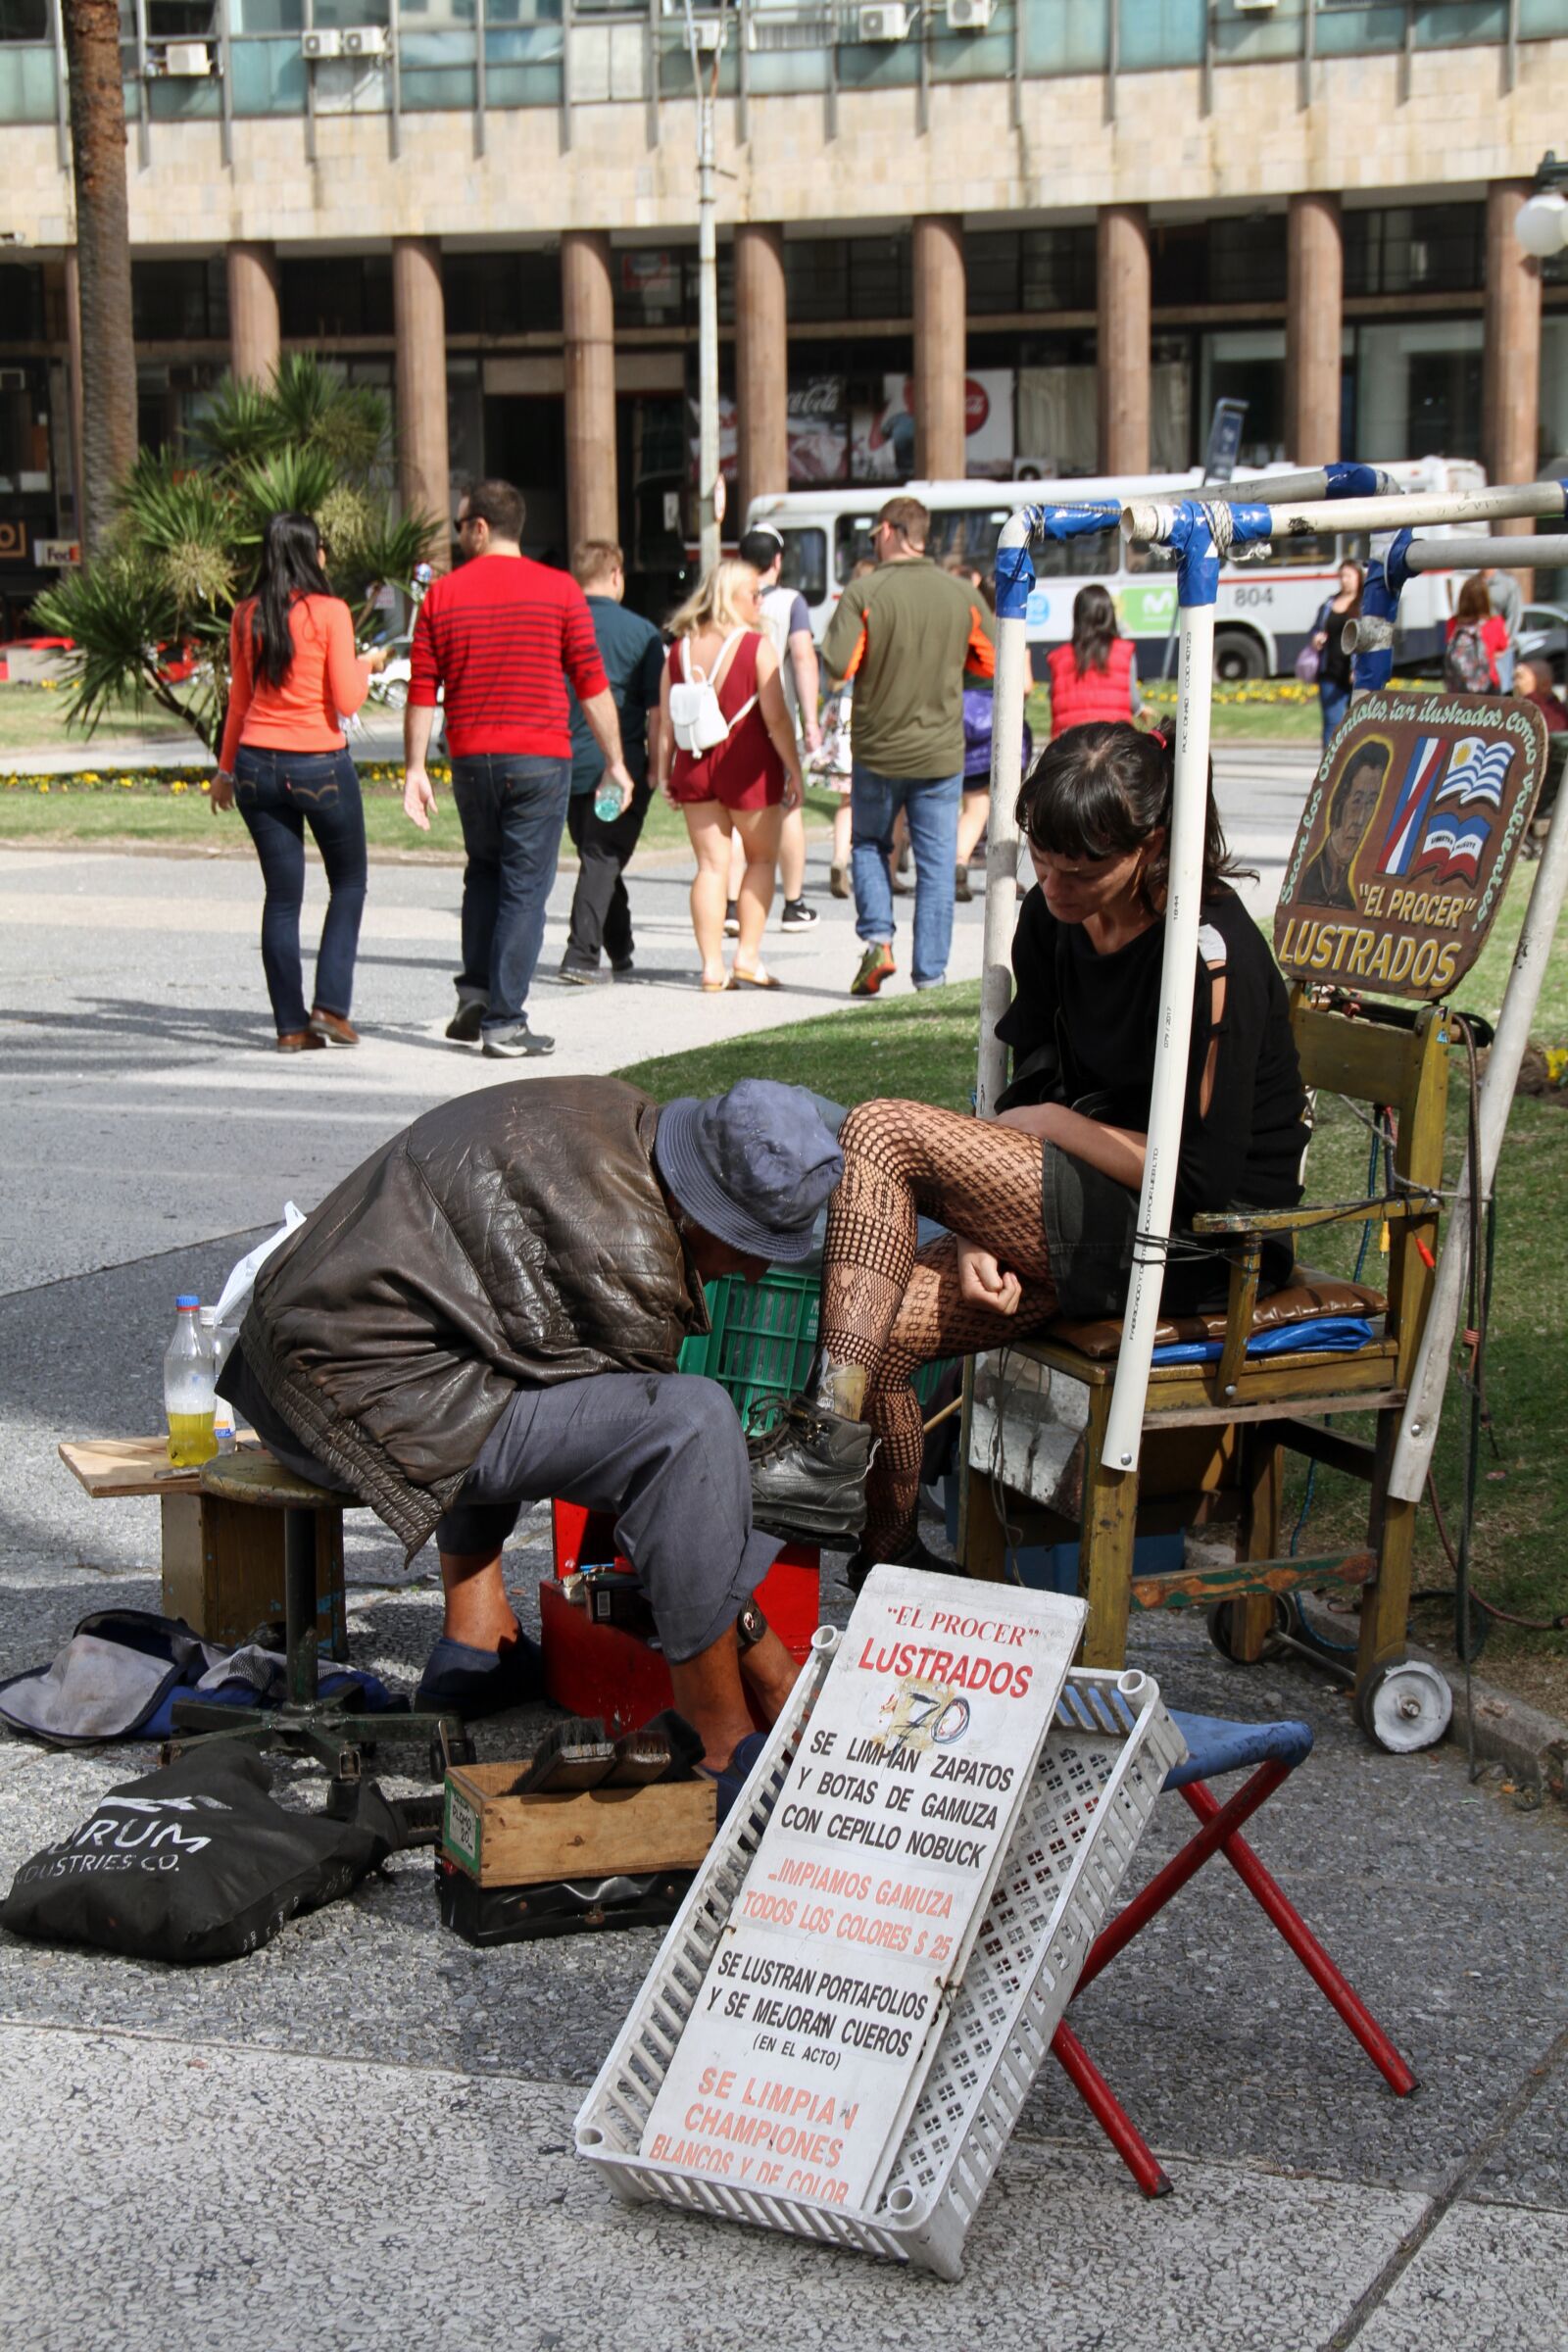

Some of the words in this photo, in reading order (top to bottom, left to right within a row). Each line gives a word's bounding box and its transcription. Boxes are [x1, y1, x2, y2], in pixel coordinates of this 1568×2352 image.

[1235, 587, 1273, 608] 804
[1389, 697, 1418, 722] tan
[1417, 695, 1505, 730] ilustrados,
[1505, 710, 1538, 765] como
[1359, 883, 1387, 918] "EL
[1386, 888, 1478, 930] PROCER"
[1278, 917, 1463, 988] LUSTRADOS
[1129, 1284, 1142, 1341] FABRICADO
[887, 1605, 927, 1629] "EL
[930, 1611, 1040, 1648] PROCER"
[858, 1637, 1034, 1699] LUSTRADOS
[809, 1730, 838, 1757] SE
[846, 1738, 922, 1774] LIMPIAN
[930, 1754, 1015, 1792] ZAPATOS
[797, 1766, 813, 1790] Y
[816, 1771, 879, 1805] BOTAS
[885, 1786, 915, 1813] DE
[921, 1792, 999, 1831] GAMUZA
[140, 1853, 180, 1872] CO.
[780, 1803, 824, 1835] CON
[826, 1813, 903, 1851] CEPILLO
[905, 1830, 988, 1869] NOBUCK
[742, 1889, 799, 1927] TODOS
[798, 1903, 835, 1935] LOS
[836, 1912, 912, 1952] COLORES
[913, 1930, 929, 1956] $
[928, 1934, 954, 1961] 25
[875, 1880, 955, 1920] GAMUZA
[717, 1949, 744, 1978] SE
[741, 1954, 818, 1995] LUSTRAN
[814, 1972, 929, 2021] PORTAFOLIOS
[706, 1985, 723, 2012] Y
[723, 1989, 751, 2019] SE
[752, 1996, 838, 2039] MEJORAN
[840, 2018, 913, 2058] CUEROS
[752, 2033, 777, 2054] (EN
[782, 2040, 797, 2058] EL
[802, 2045, 842, 2071] ACTO)
[698, 2067, 737, 2100] SE
[684, 2102, 844, 2170] CHAMPIONES
[649, 2133, 735, 2175] BLANCOS
[739, 2156, 755, 2180] Y
[755, 2160, 784, 2185] DE
[786, 2169, 850, 2205] COLOR
